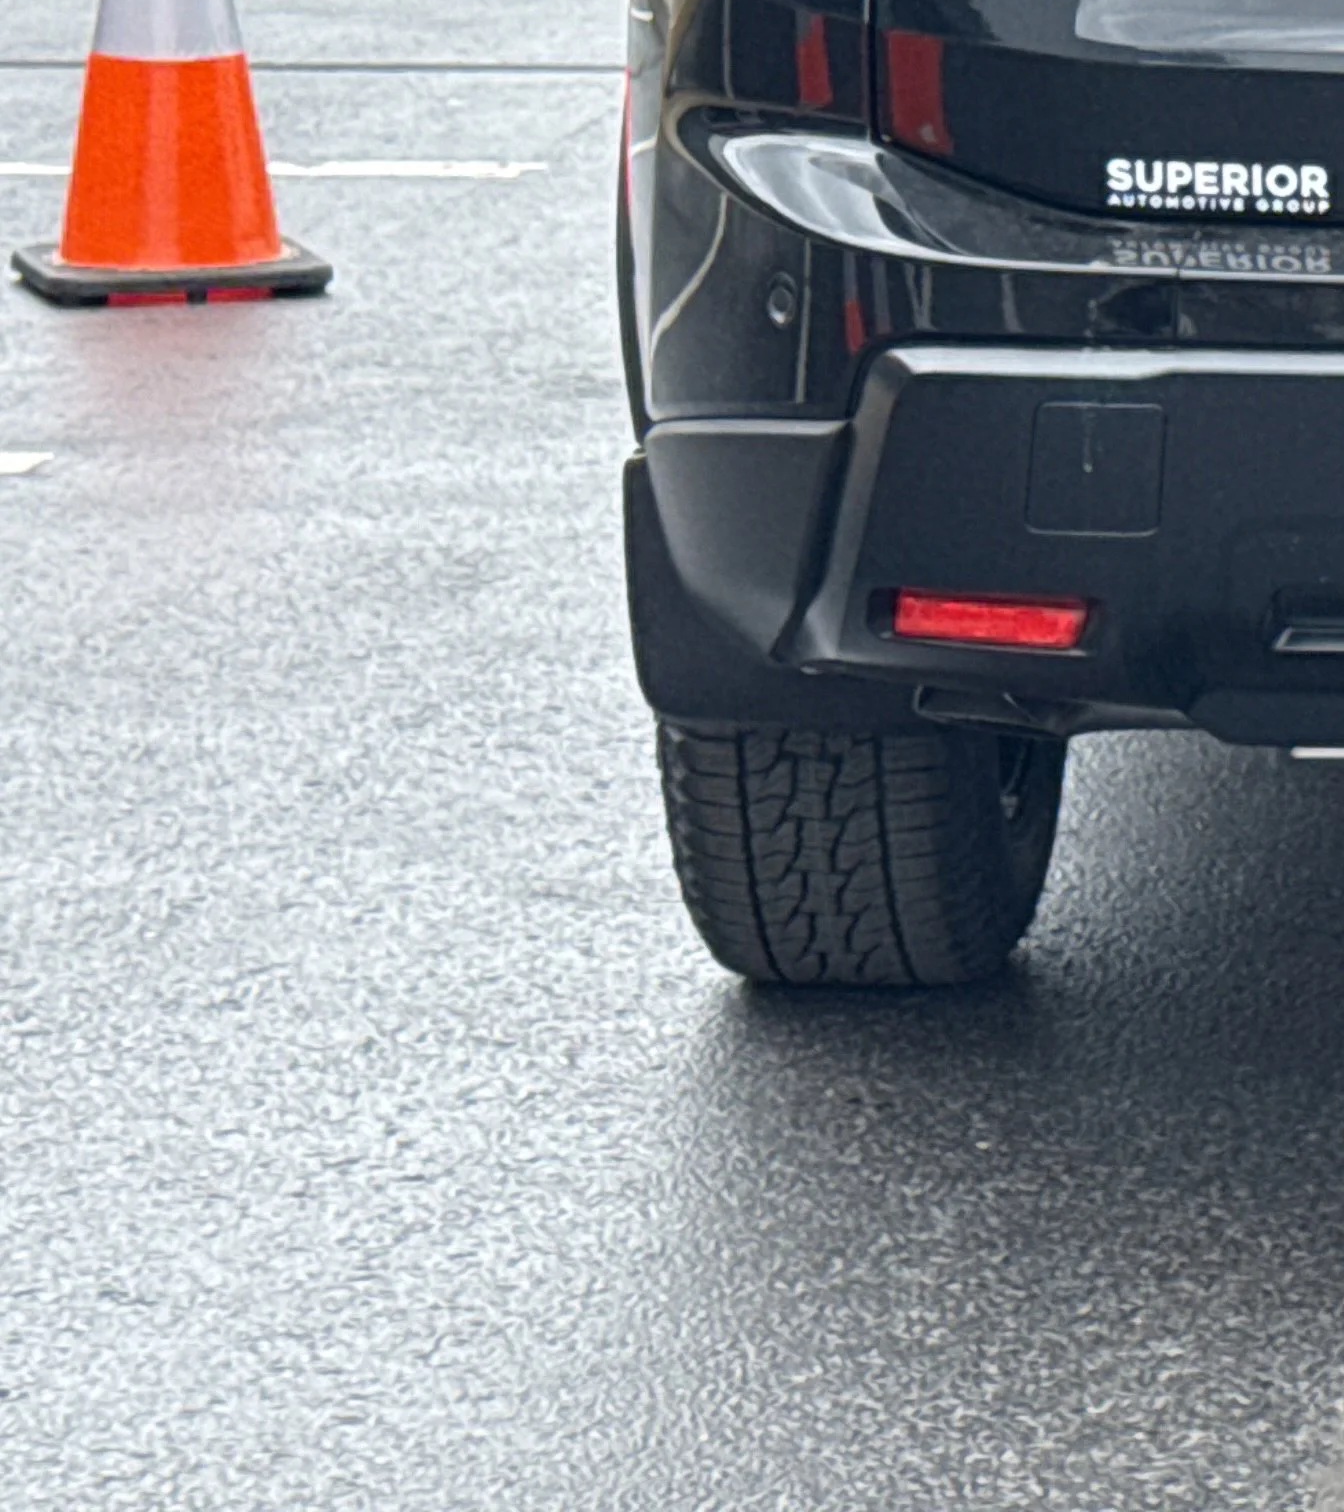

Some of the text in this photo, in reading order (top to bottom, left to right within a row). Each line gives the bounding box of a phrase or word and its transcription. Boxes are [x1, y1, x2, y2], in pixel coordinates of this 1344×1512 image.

[1106, 158, 1330, 199] SUPERIOR
[1106, 192, 1330, 216] AUTOMOTIVE GROUP
